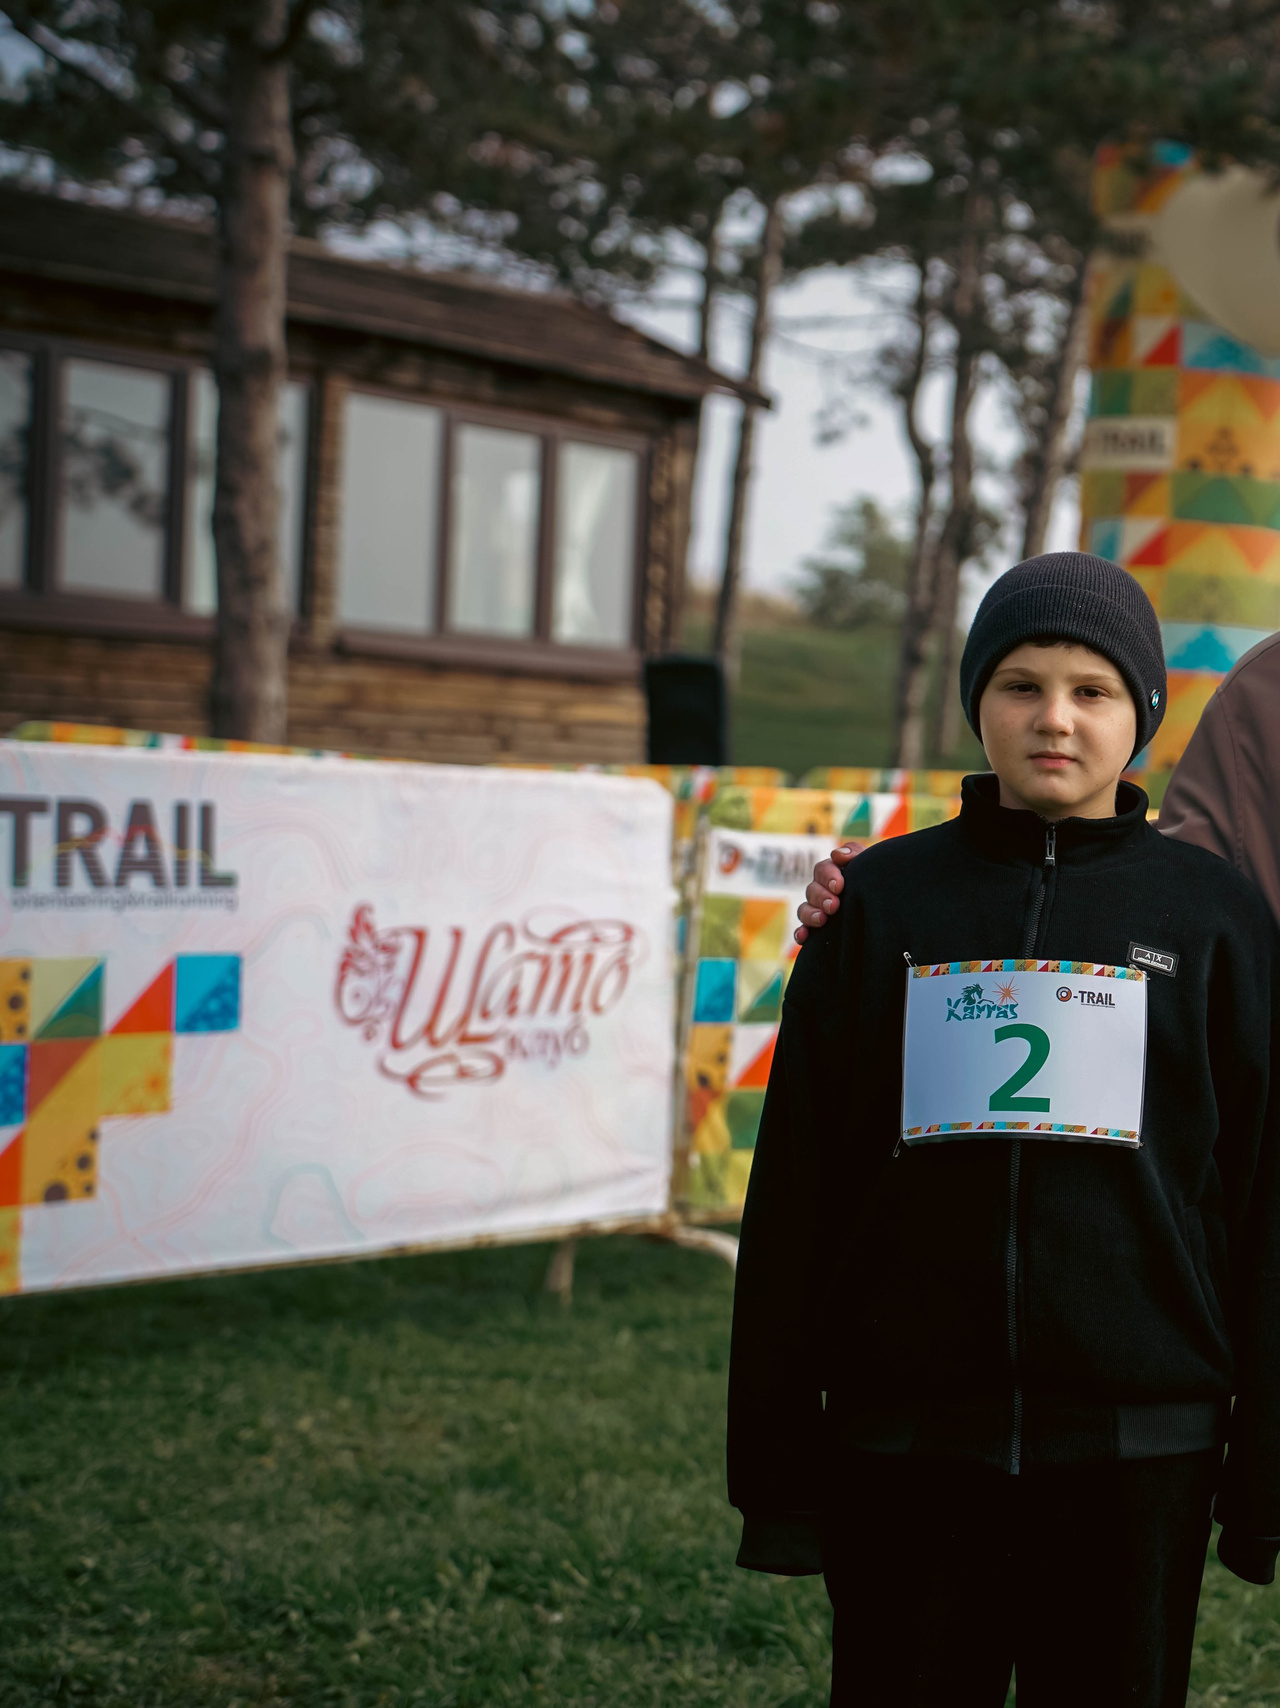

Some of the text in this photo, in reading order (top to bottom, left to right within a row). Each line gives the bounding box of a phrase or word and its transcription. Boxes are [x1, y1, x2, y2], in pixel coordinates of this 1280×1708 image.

[0, 797, 237, 887] TRAIL
[945, 997, 1019, 1022] Karras
[1056, 986, 1115, 1006] O-TRAIL
[989, 1023, 1051, 1112] 2
